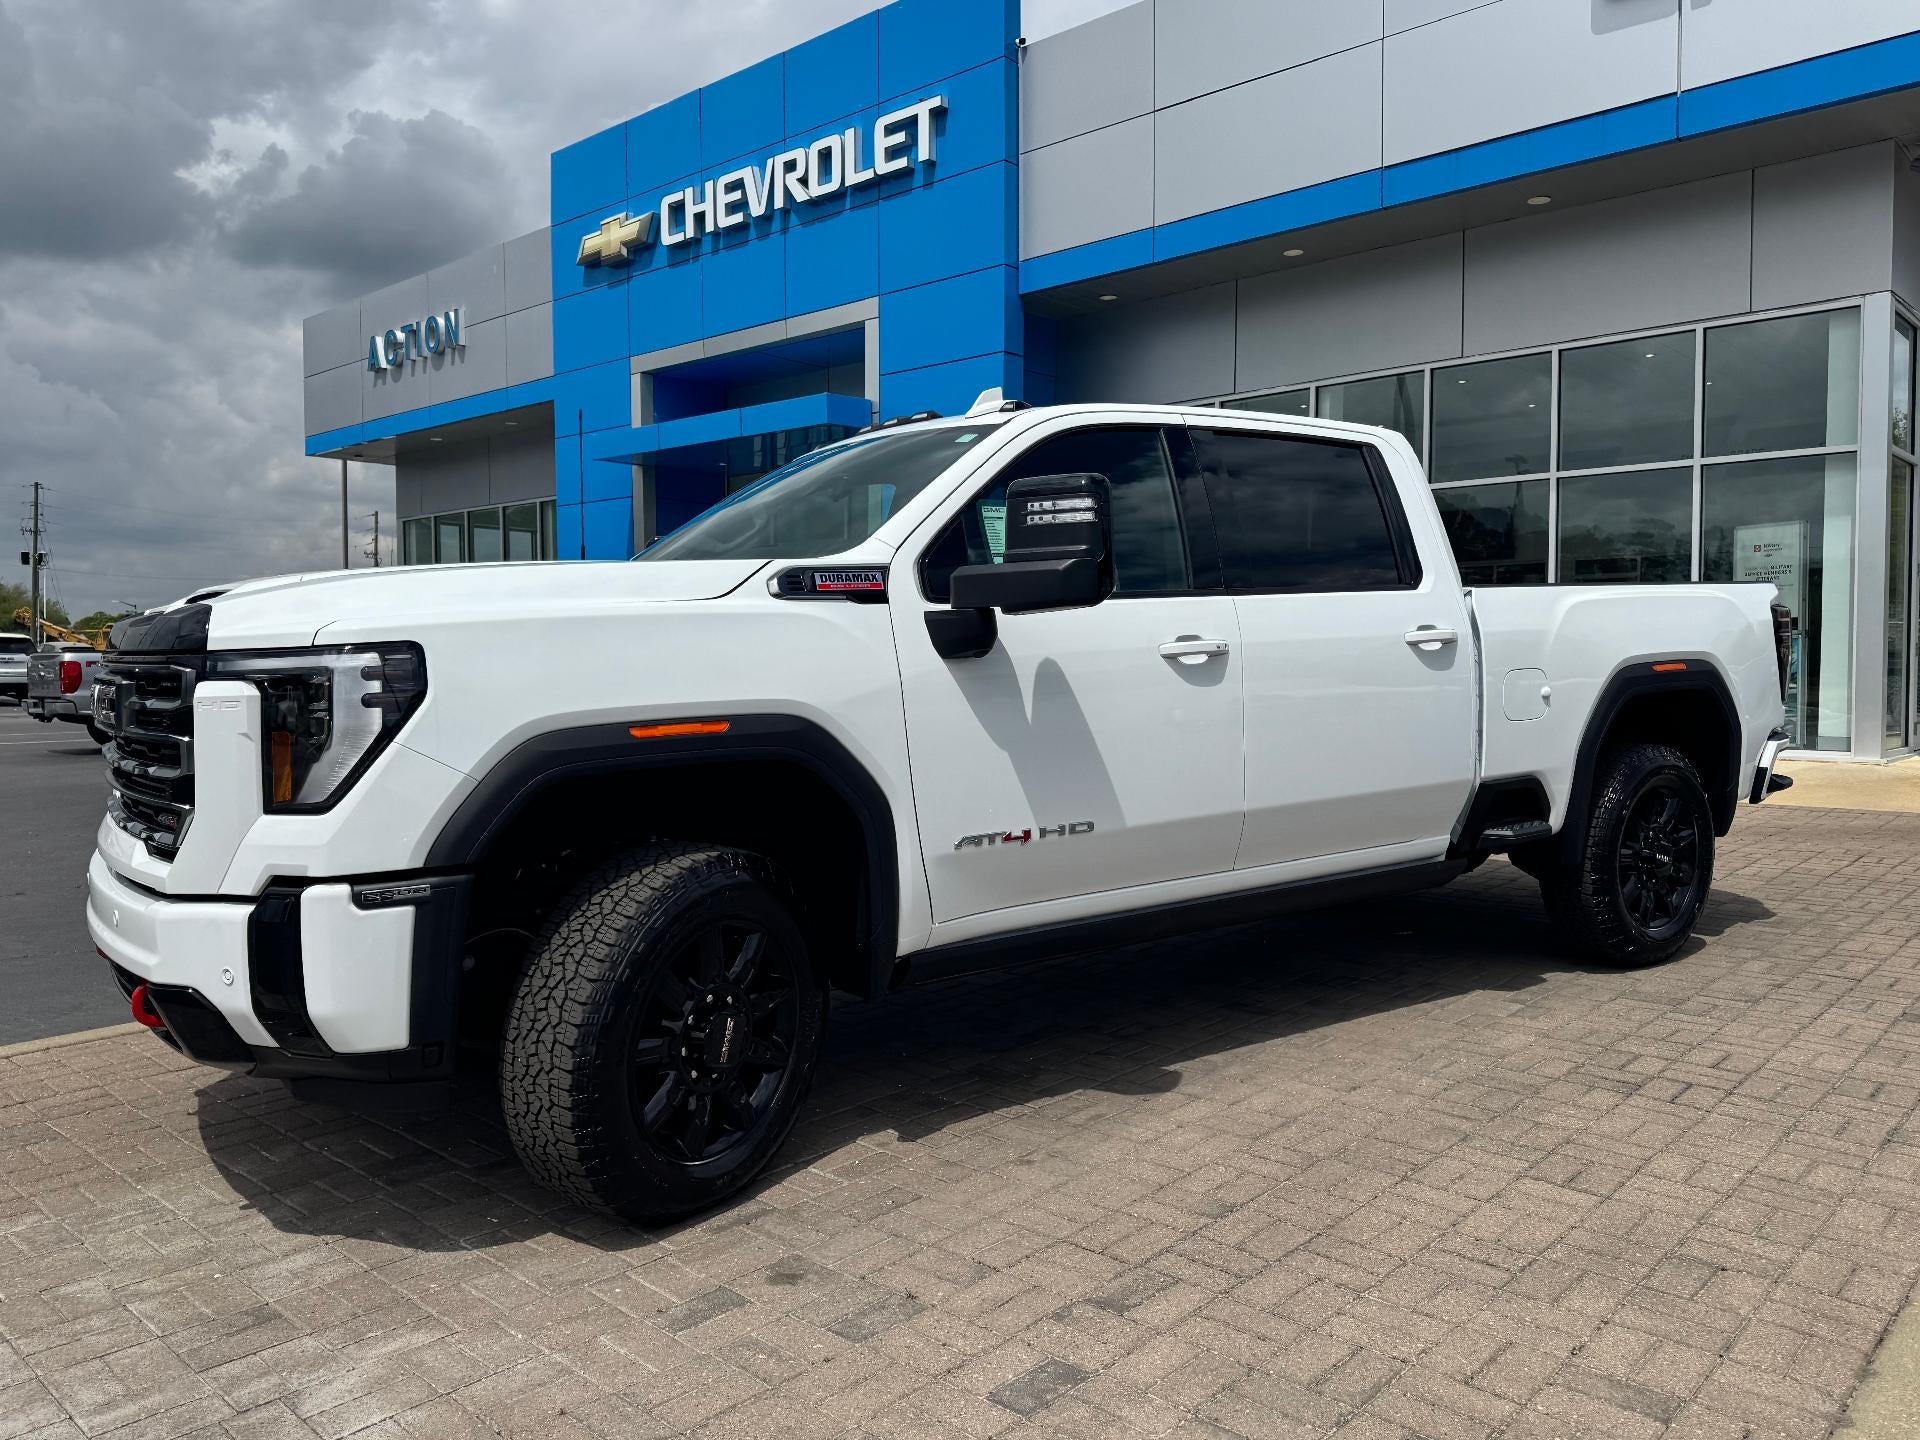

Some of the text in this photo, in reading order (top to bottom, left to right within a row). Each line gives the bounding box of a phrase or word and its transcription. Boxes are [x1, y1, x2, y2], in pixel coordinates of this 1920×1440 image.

[660, 94, 948, 247] CHEVROLET
[367, 308, 466, 373] ACTION
[820, 572, 880, 583] DURAMAX
[954, 820, 1096, 851] AT4 HD
